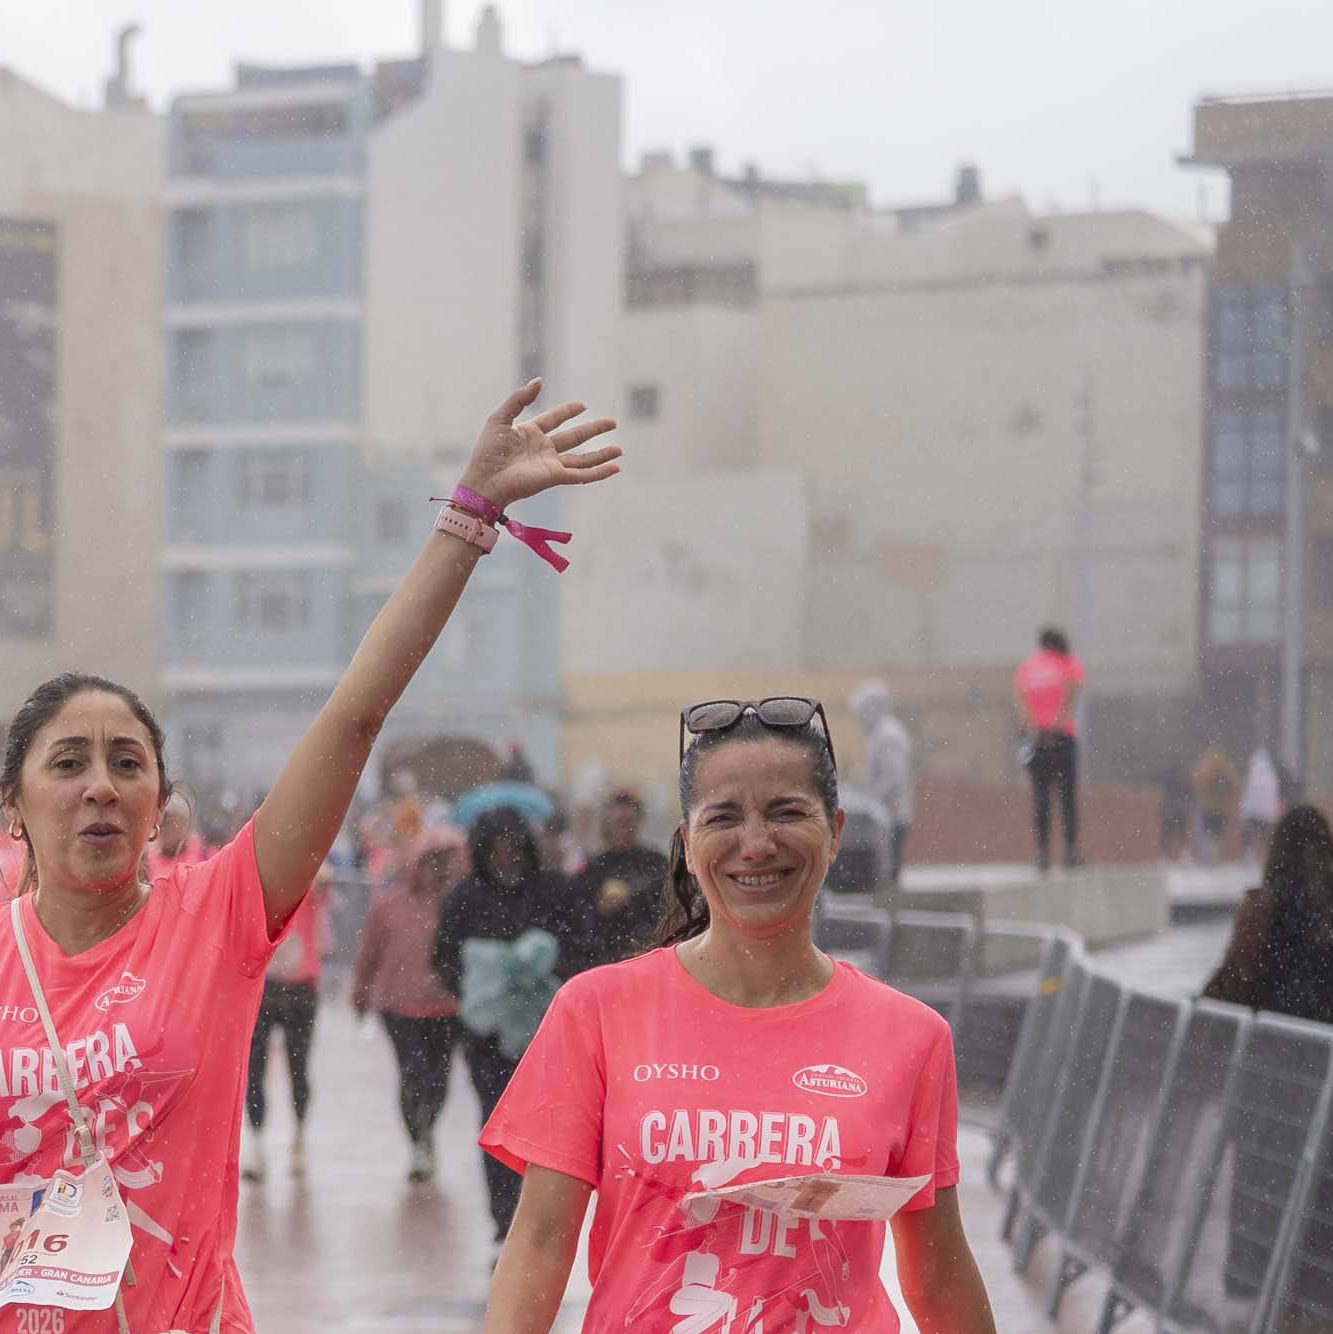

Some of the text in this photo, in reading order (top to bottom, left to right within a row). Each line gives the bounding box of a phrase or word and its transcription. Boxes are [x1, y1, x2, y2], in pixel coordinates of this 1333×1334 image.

[633, 1063, 720, 1082] OYSHO
[640, 1108, 843, 1170] CARRERA
[40, 1269, 69, 1280] GRAN
[69, 1272, 113, 1285] CANARIA
